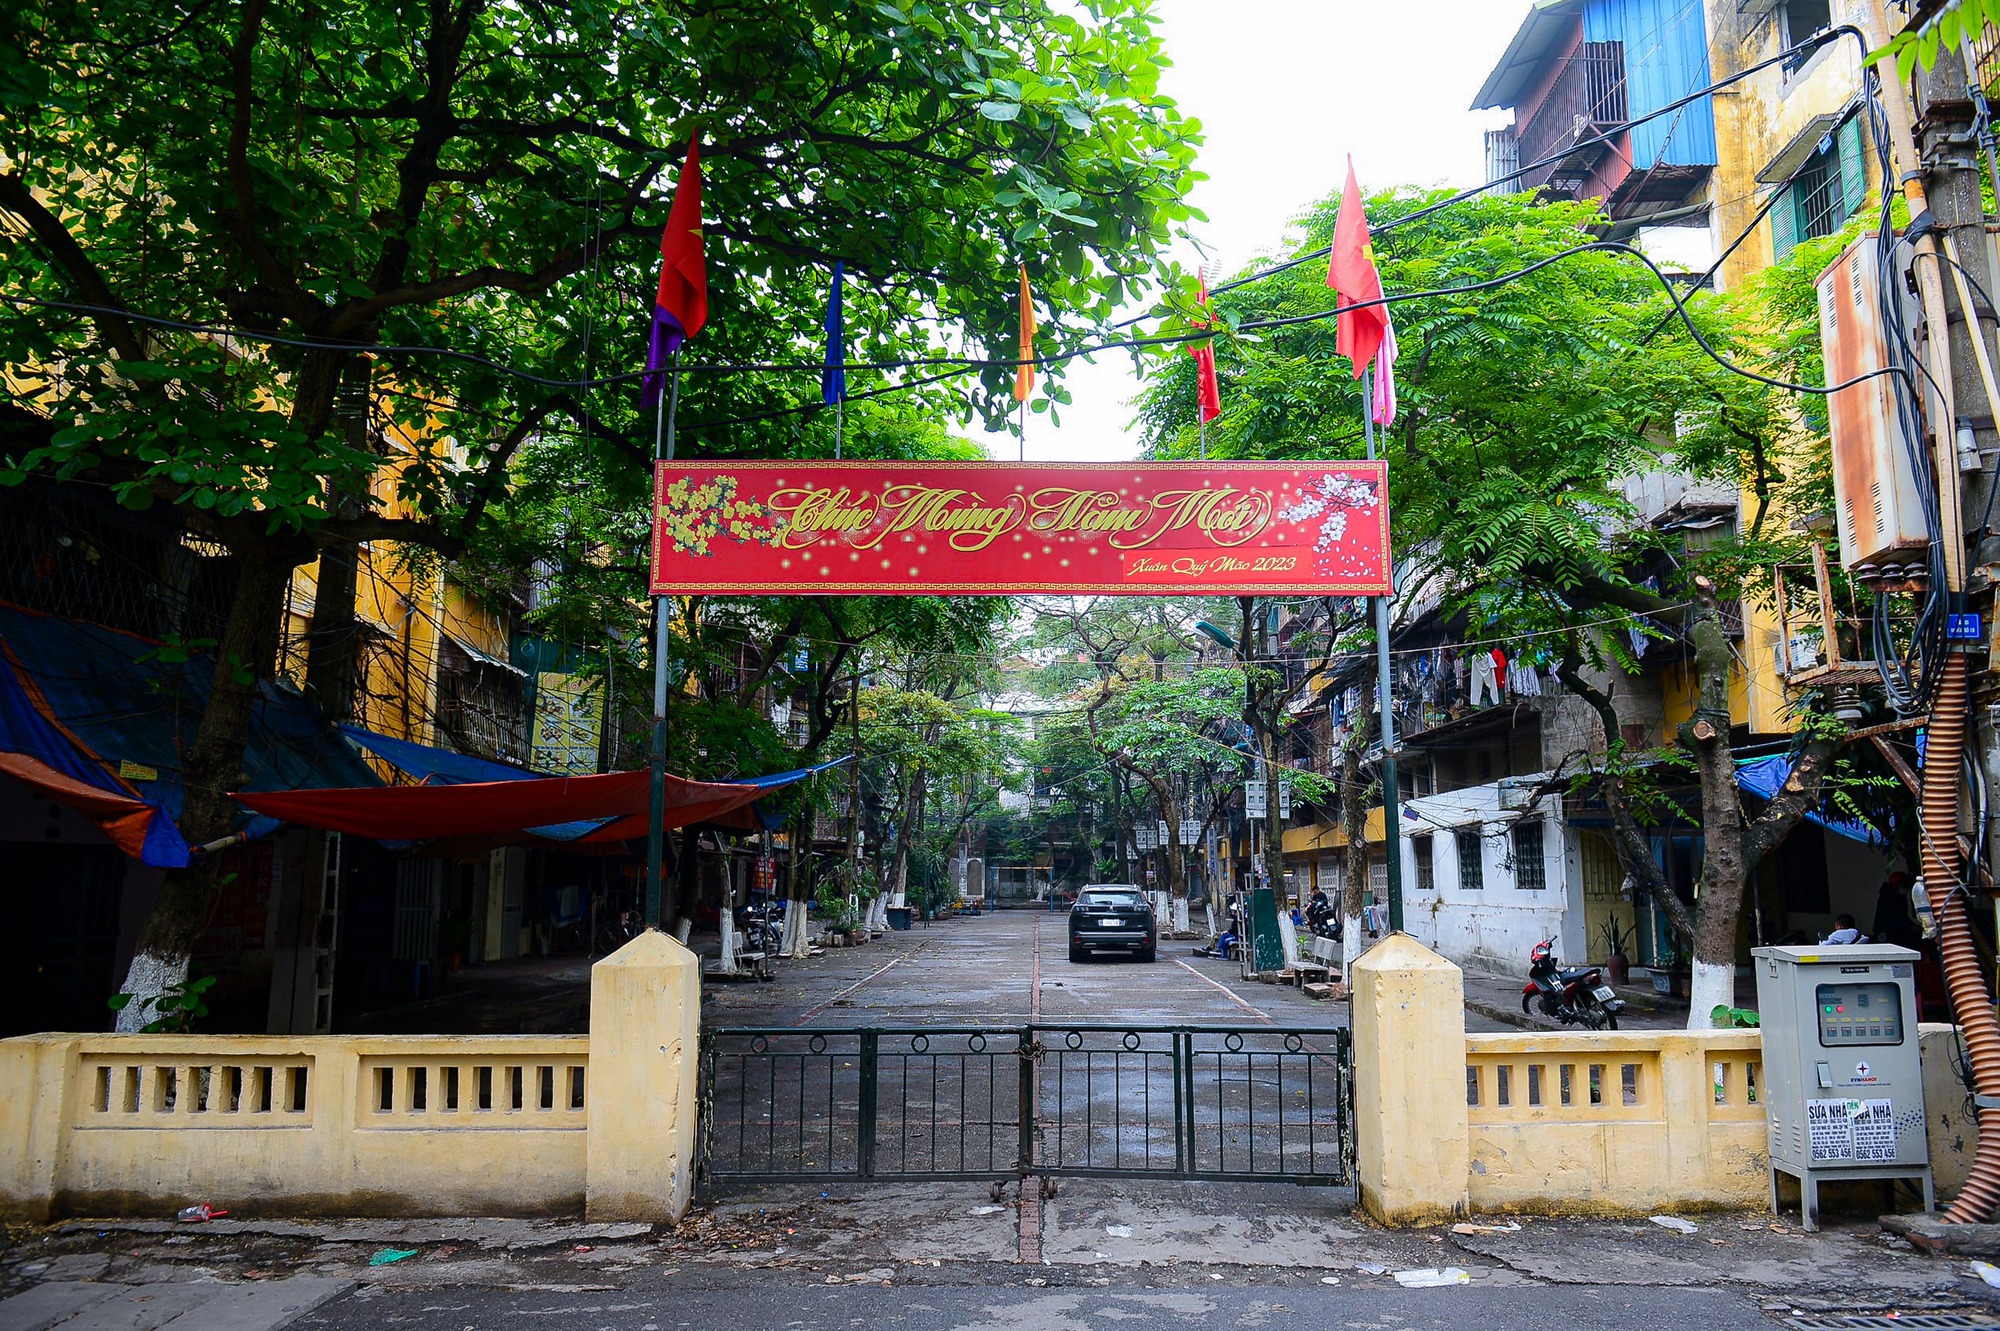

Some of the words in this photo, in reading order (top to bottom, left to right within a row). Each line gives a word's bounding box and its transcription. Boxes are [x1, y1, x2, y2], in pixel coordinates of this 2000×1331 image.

[768, 488, 880, 550] Chúc
[849, 484, 1028, 552] Mừng
[1108, 488, 1272, 548] Mới
[1126, 557, 1169, 576] Xuân
[1171, 557, 1209, 577] Quý
[1209, 556, 1250, 573] Mão
[1251, 556, 1297, 572] 2023
[1808, 1099, 1828, 1119] SỬA
[1829, 1101, 1848, 1119] NHÀ
[1872, 1101, 1892, 1119] NHÀ
[1812, 1149, 1827, 1159] 0562
[1828, 1148, 1840, 1158] 553
[1855, 1149, 1871, 1160] 0562
[1872, 1149, 1883, 1159] 553
